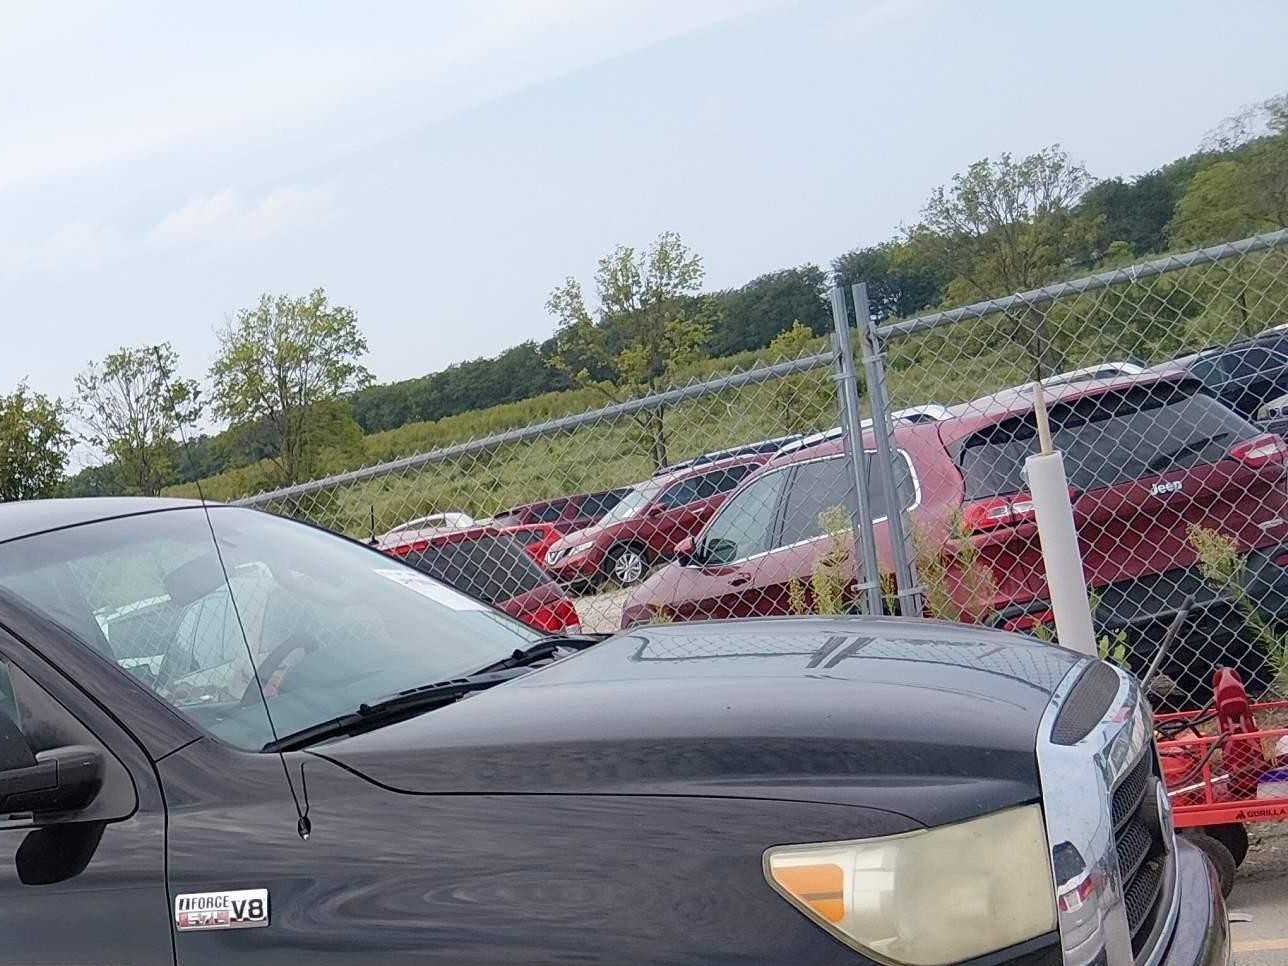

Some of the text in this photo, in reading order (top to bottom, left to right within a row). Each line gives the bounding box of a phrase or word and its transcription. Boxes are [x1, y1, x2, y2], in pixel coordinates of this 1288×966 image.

[1151, 480, 1183, 496] Jeep
[1246, 808, 1287, 818] GORILLA
[231, 898, 265, 921] V8
